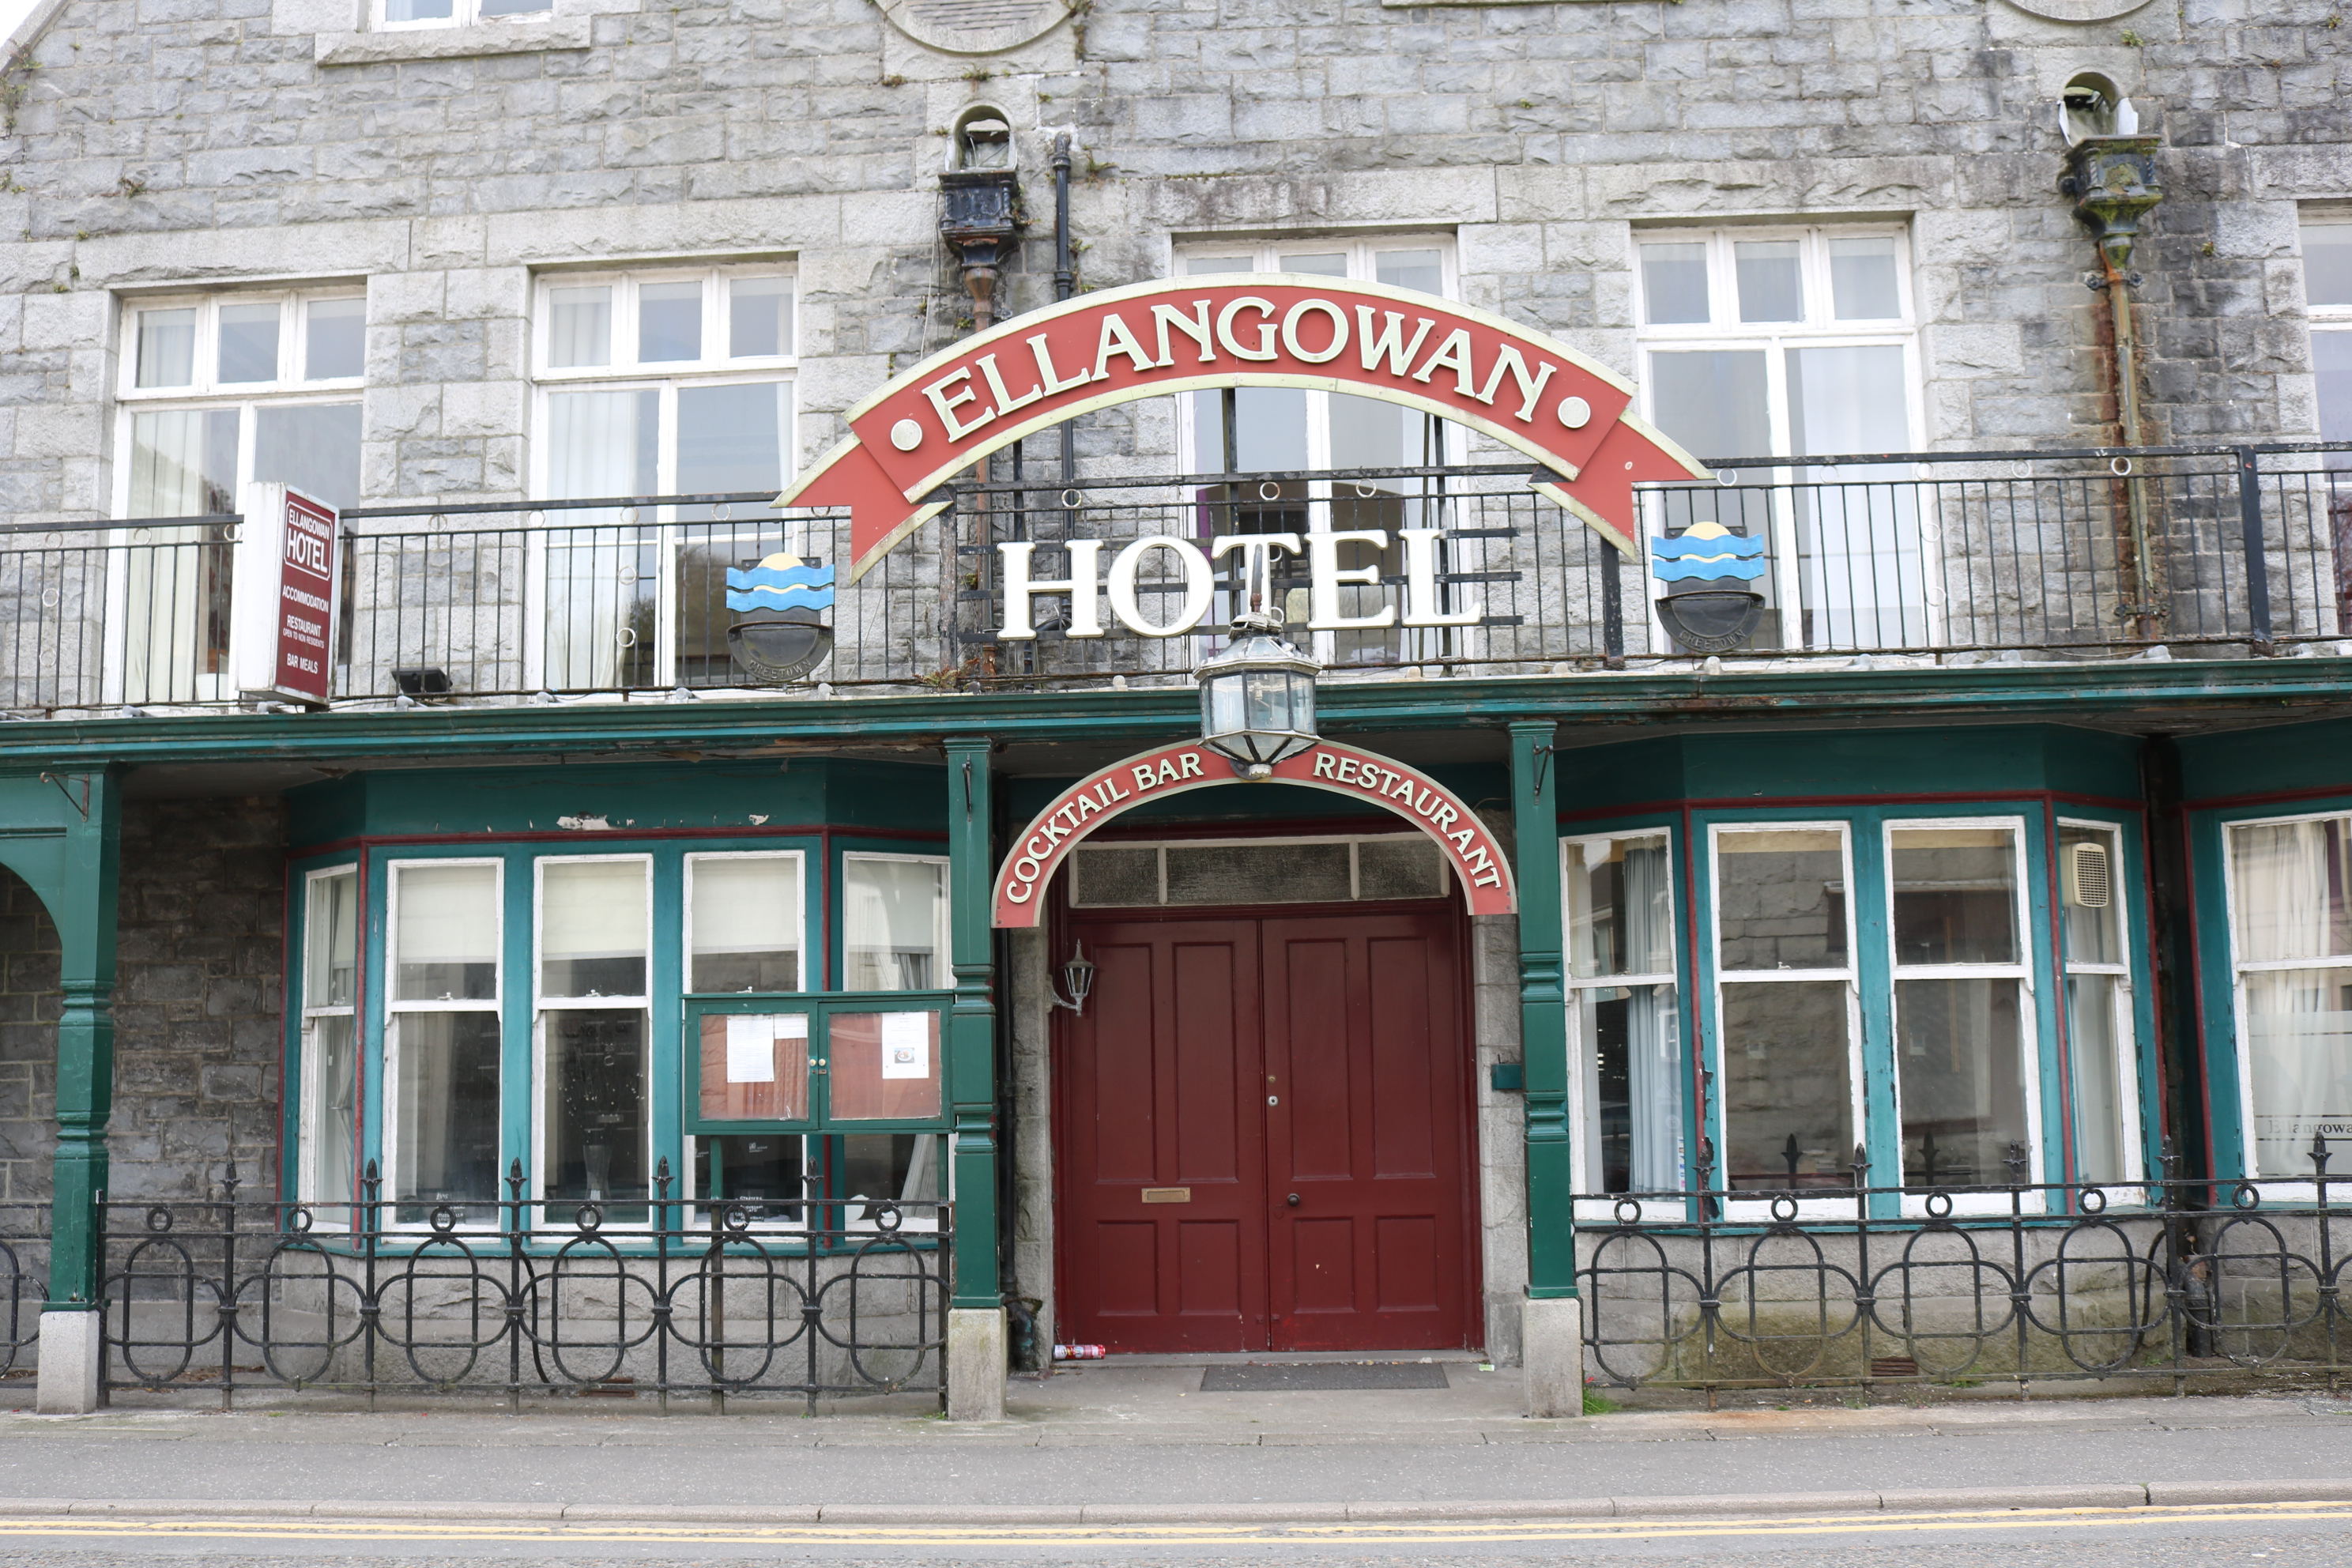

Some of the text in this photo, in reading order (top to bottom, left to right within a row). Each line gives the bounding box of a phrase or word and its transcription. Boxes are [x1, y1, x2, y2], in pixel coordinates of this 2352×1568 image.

[921, 296, 1558, 443] ELLANGOWAN
[288, 508, 330, 541] ELLANGOWAN
[286, 527, 328, 574] HOTEL
[282, 584, 329, 613] ACCOMMODATION
[996, 527, 1482, 642] HOTEL
[283, 628, 292, 639] OPEN
[292, 631, 298, 639] TO
[306, 635, 325, 650] RESIDENTS
[287, 614, 322, 638] RESTAURANT
[1679, 629, 1747, 650] CREETOWN
[287, 652, 318, 675] BAR MEALS
[748, 658, 812, 680] CREETOWN
[1006, 752, 1204, 904] COCKTAIL BAR
[1312, 751, 1502, 889] RESTAURANT
[2268, 1119, 2352, 1134] Ellangowa
